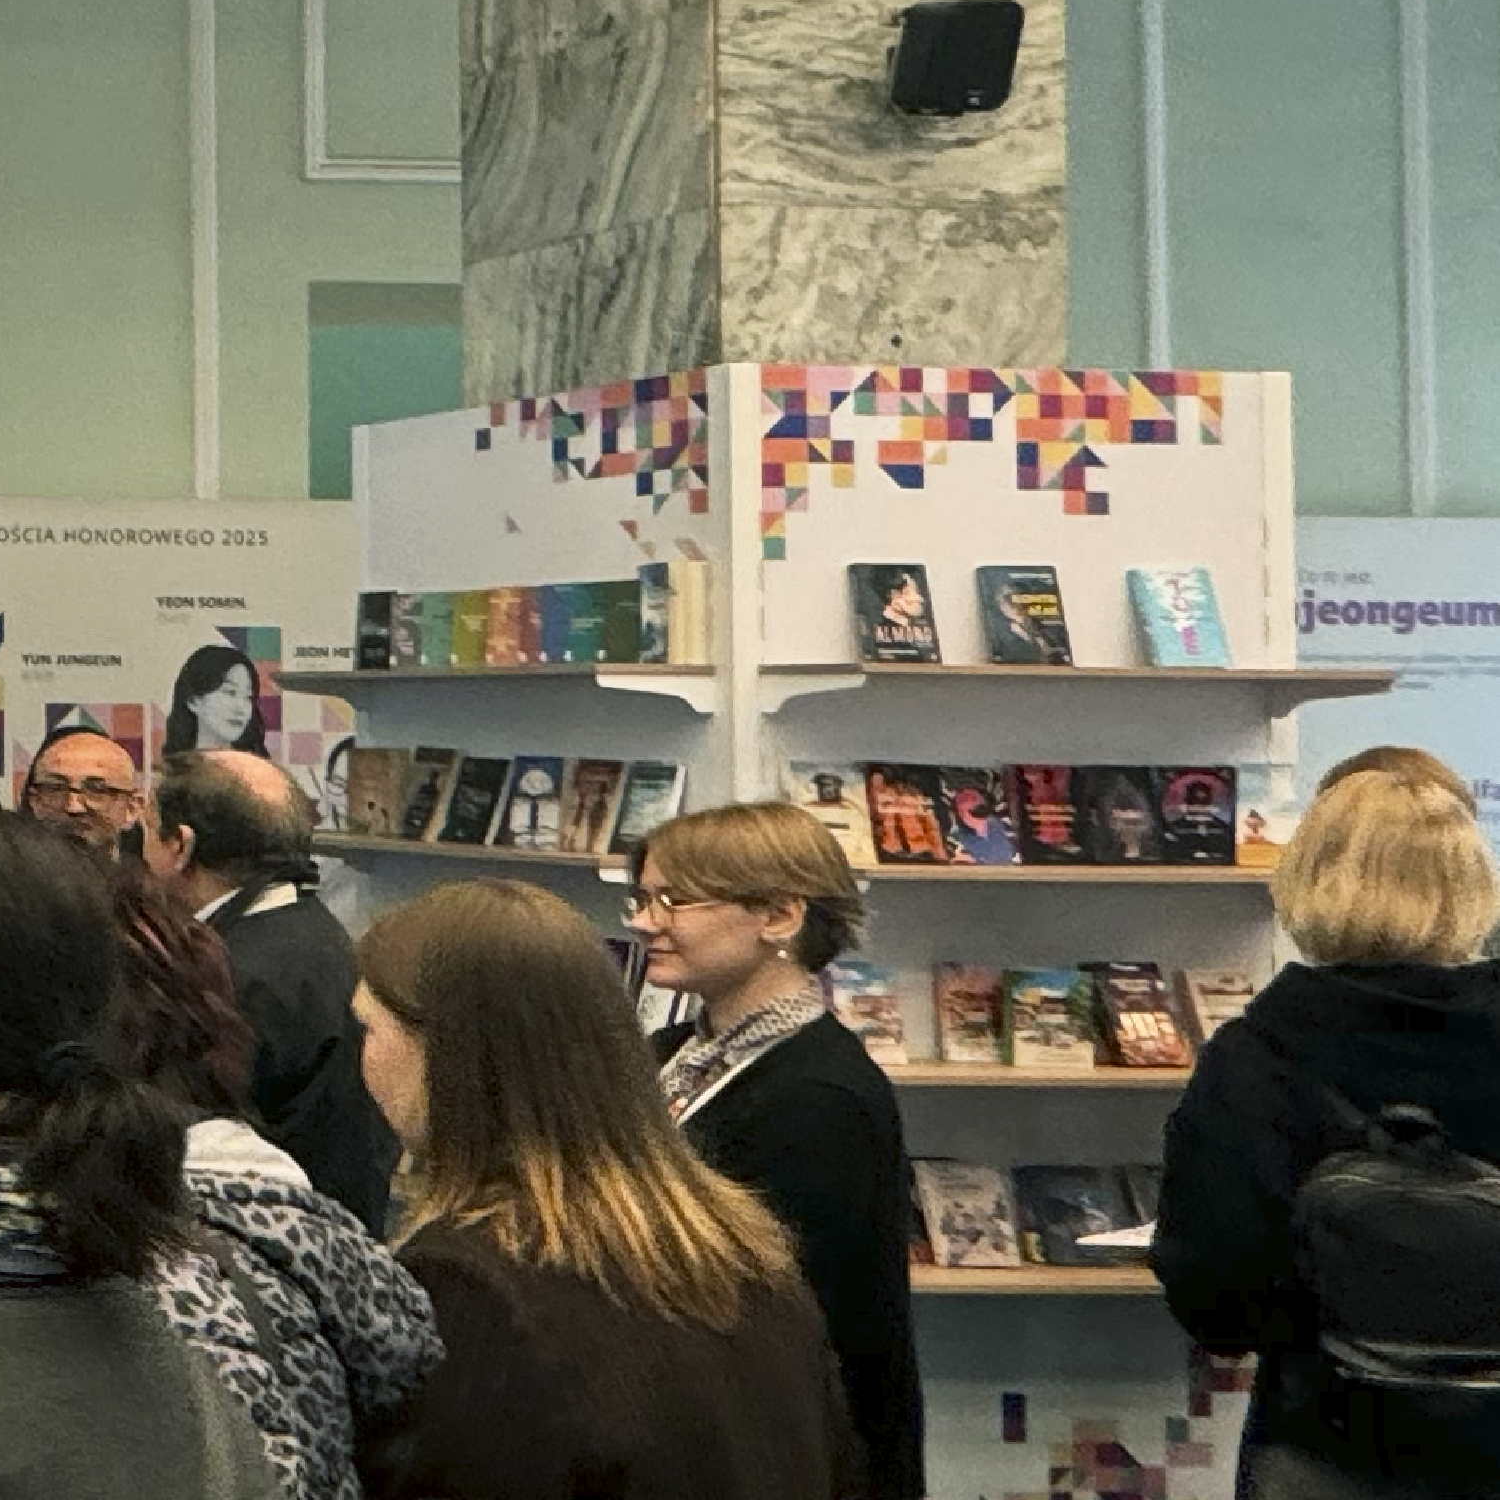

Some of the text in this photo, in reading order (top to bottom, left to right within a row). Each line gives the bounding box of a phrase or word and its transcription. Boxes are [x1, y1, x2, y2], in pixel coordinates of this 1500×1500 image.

[63, 528, 215, 546] HONOROWEGO
[222, 529, 268, 546] 2025
[1295, 589, 1500, 635] jeongeum
